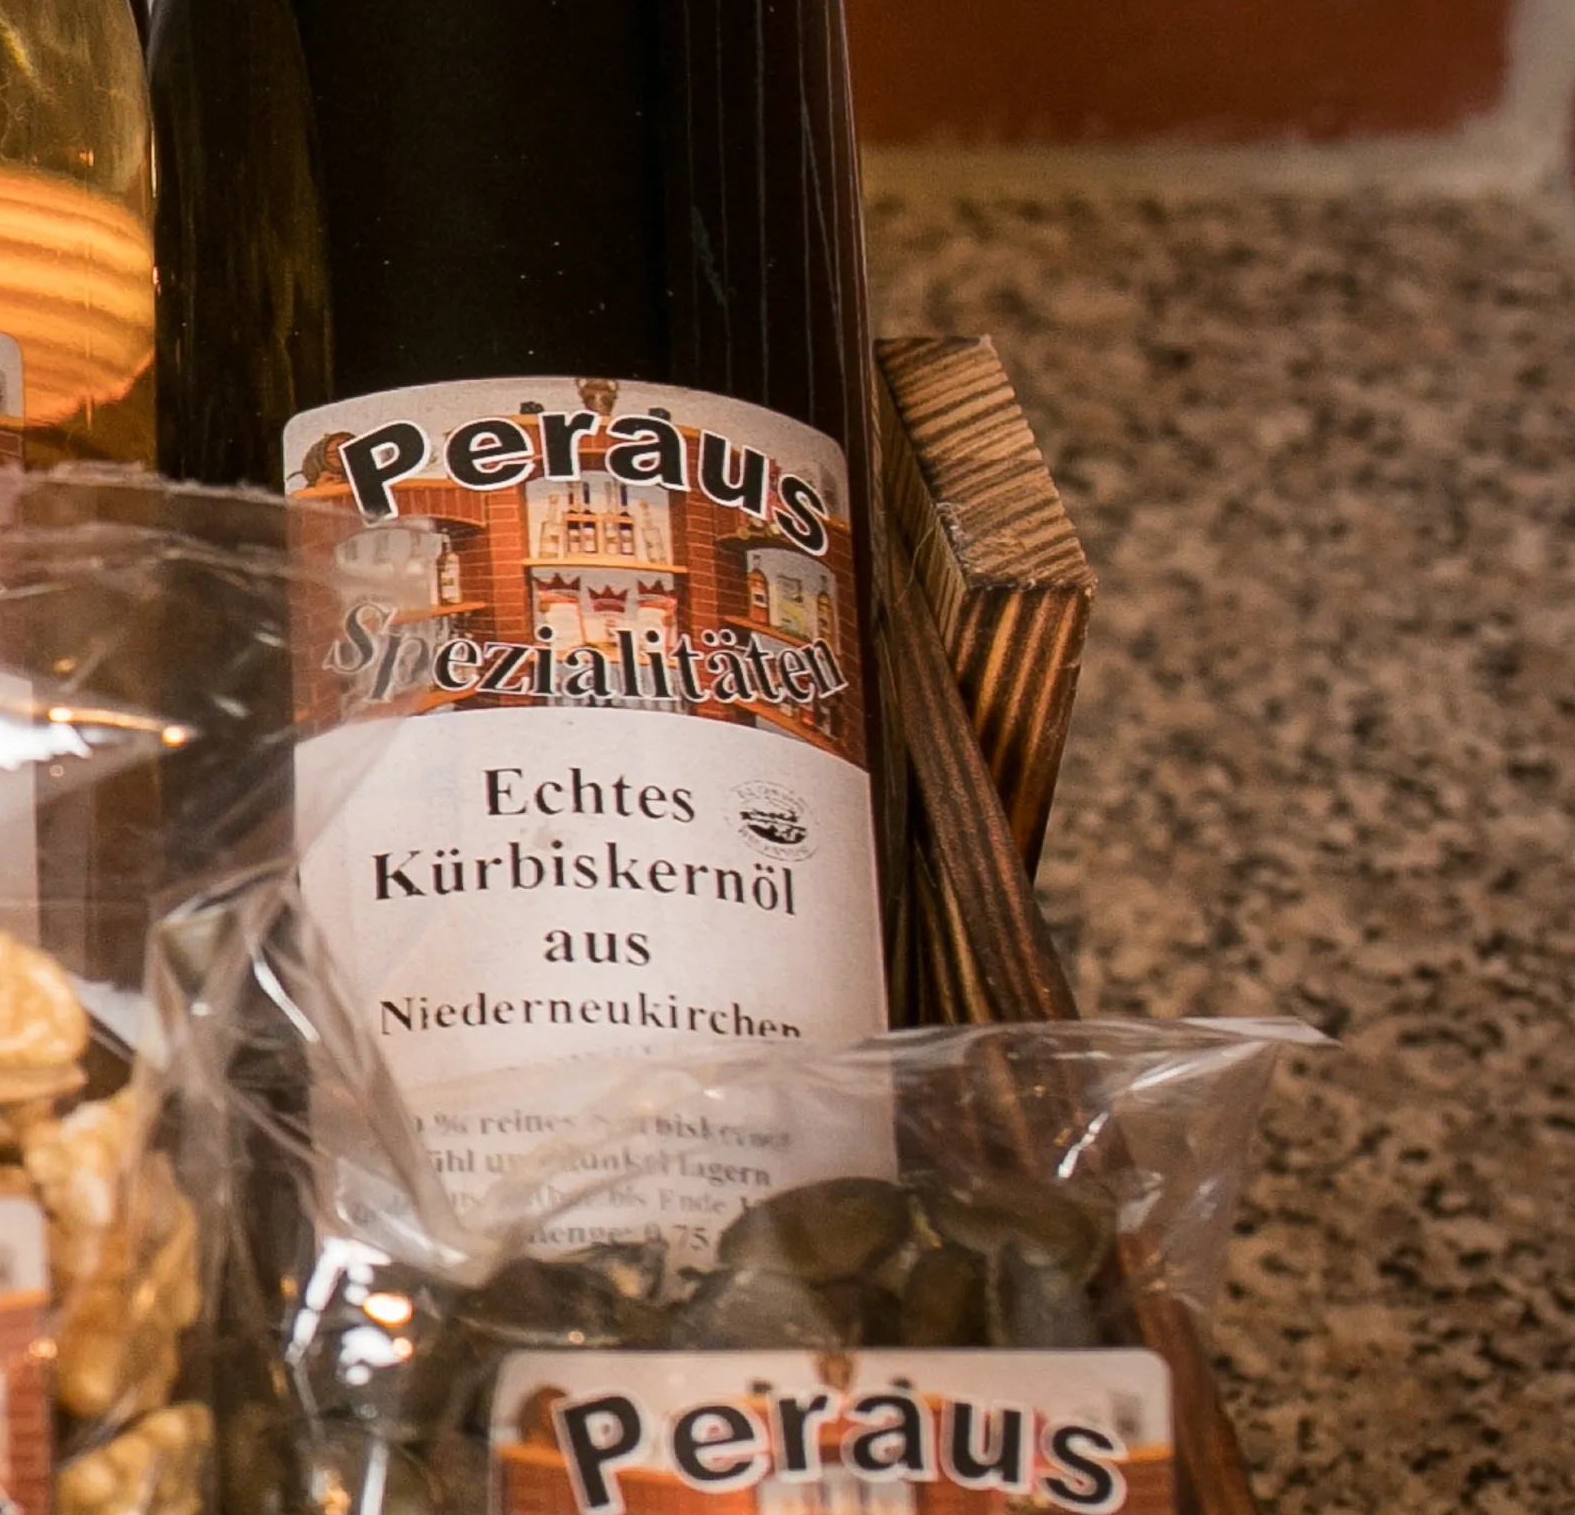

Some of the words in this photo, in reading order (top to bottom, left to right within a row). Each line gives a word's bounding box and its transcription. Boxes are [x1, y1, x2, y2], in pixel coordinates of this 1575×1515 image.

[339, 402, 830, 557] Peraus
[323, 600, 849, 704] Spezialitäten
[482, 766, 698, 825] Echtes
[373, 840, 798, 917] Kürbiskernöl
[543, 927, 653, 967] aus
[379, 991, 803, 1039] Niederneukirchen
